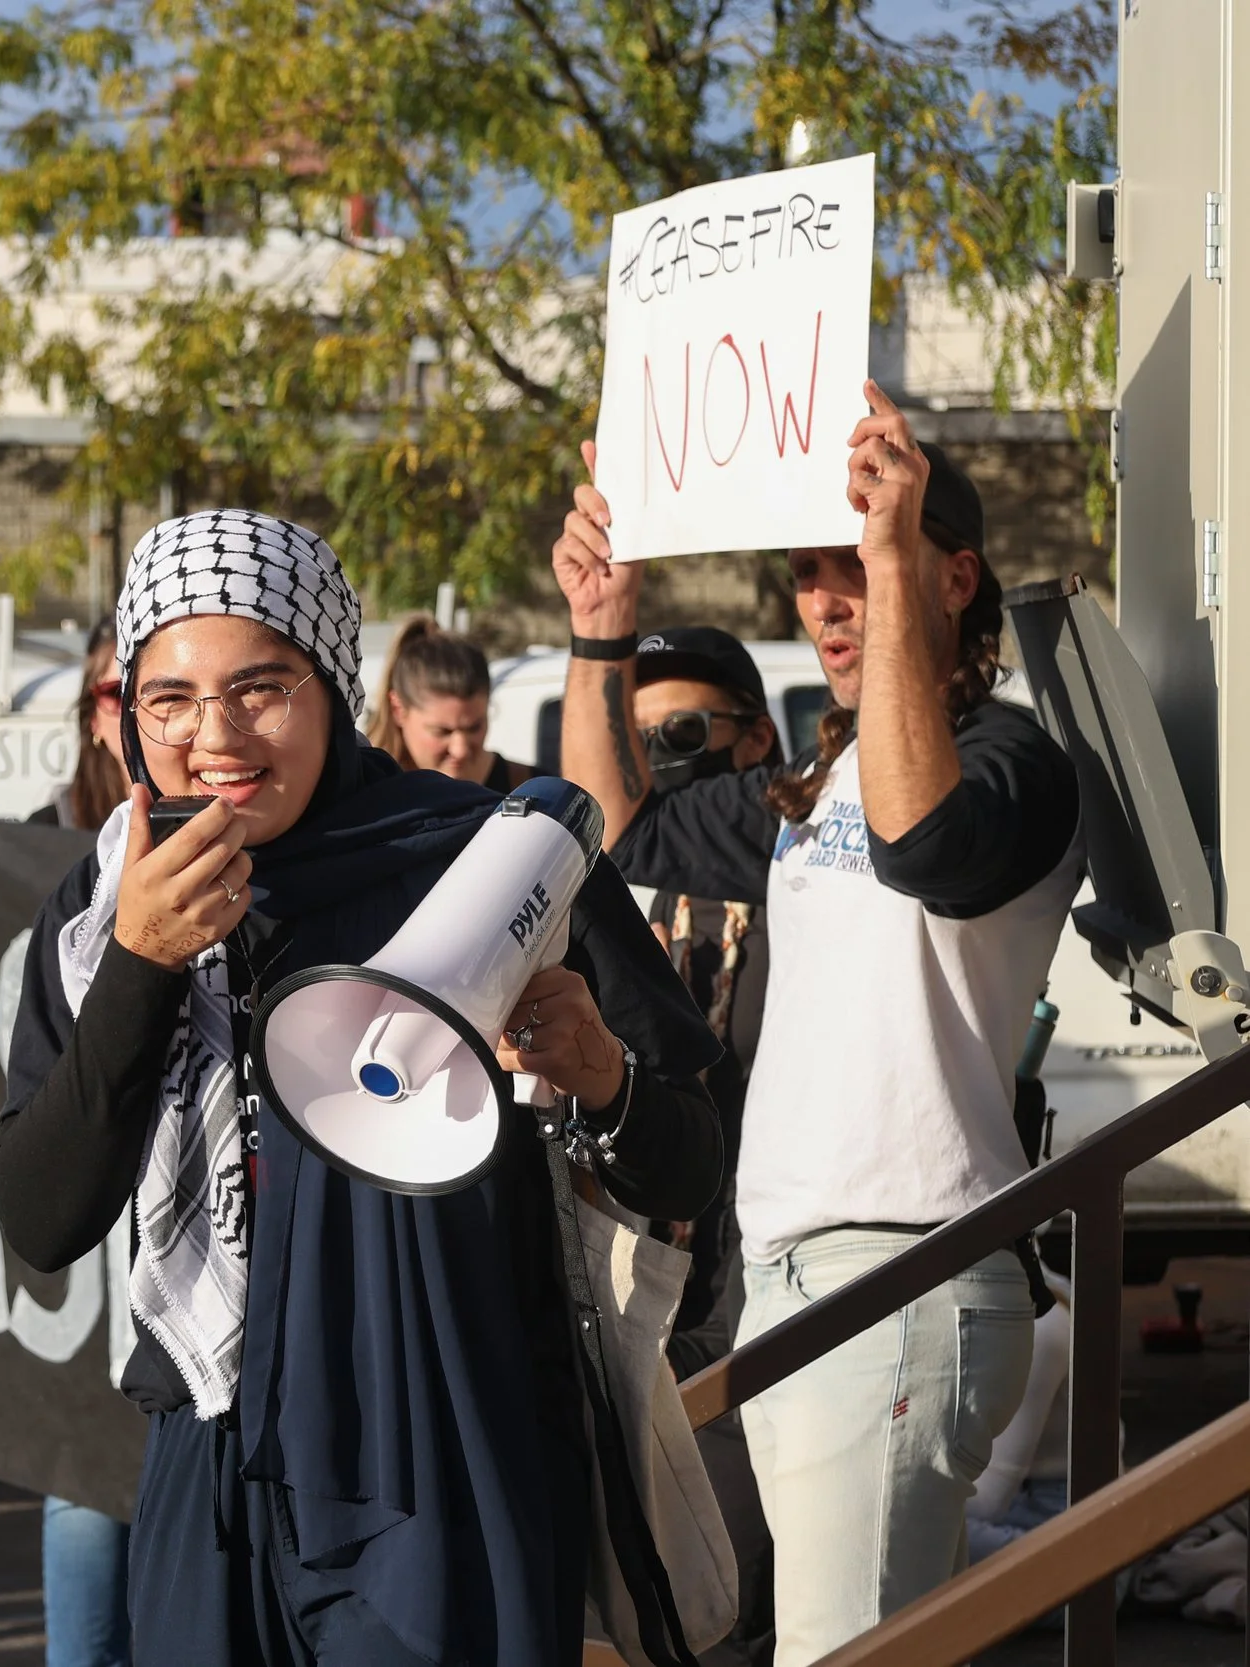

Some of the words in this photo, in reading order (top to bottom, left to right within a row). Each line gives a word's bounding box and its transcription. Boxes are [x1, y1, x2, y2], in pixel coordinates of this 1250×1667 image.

[619, 192, 841, 303] #CEASEFIRE
[643, 309, 823, 508] NOW
[507, 882, 552, 950] PYLE
